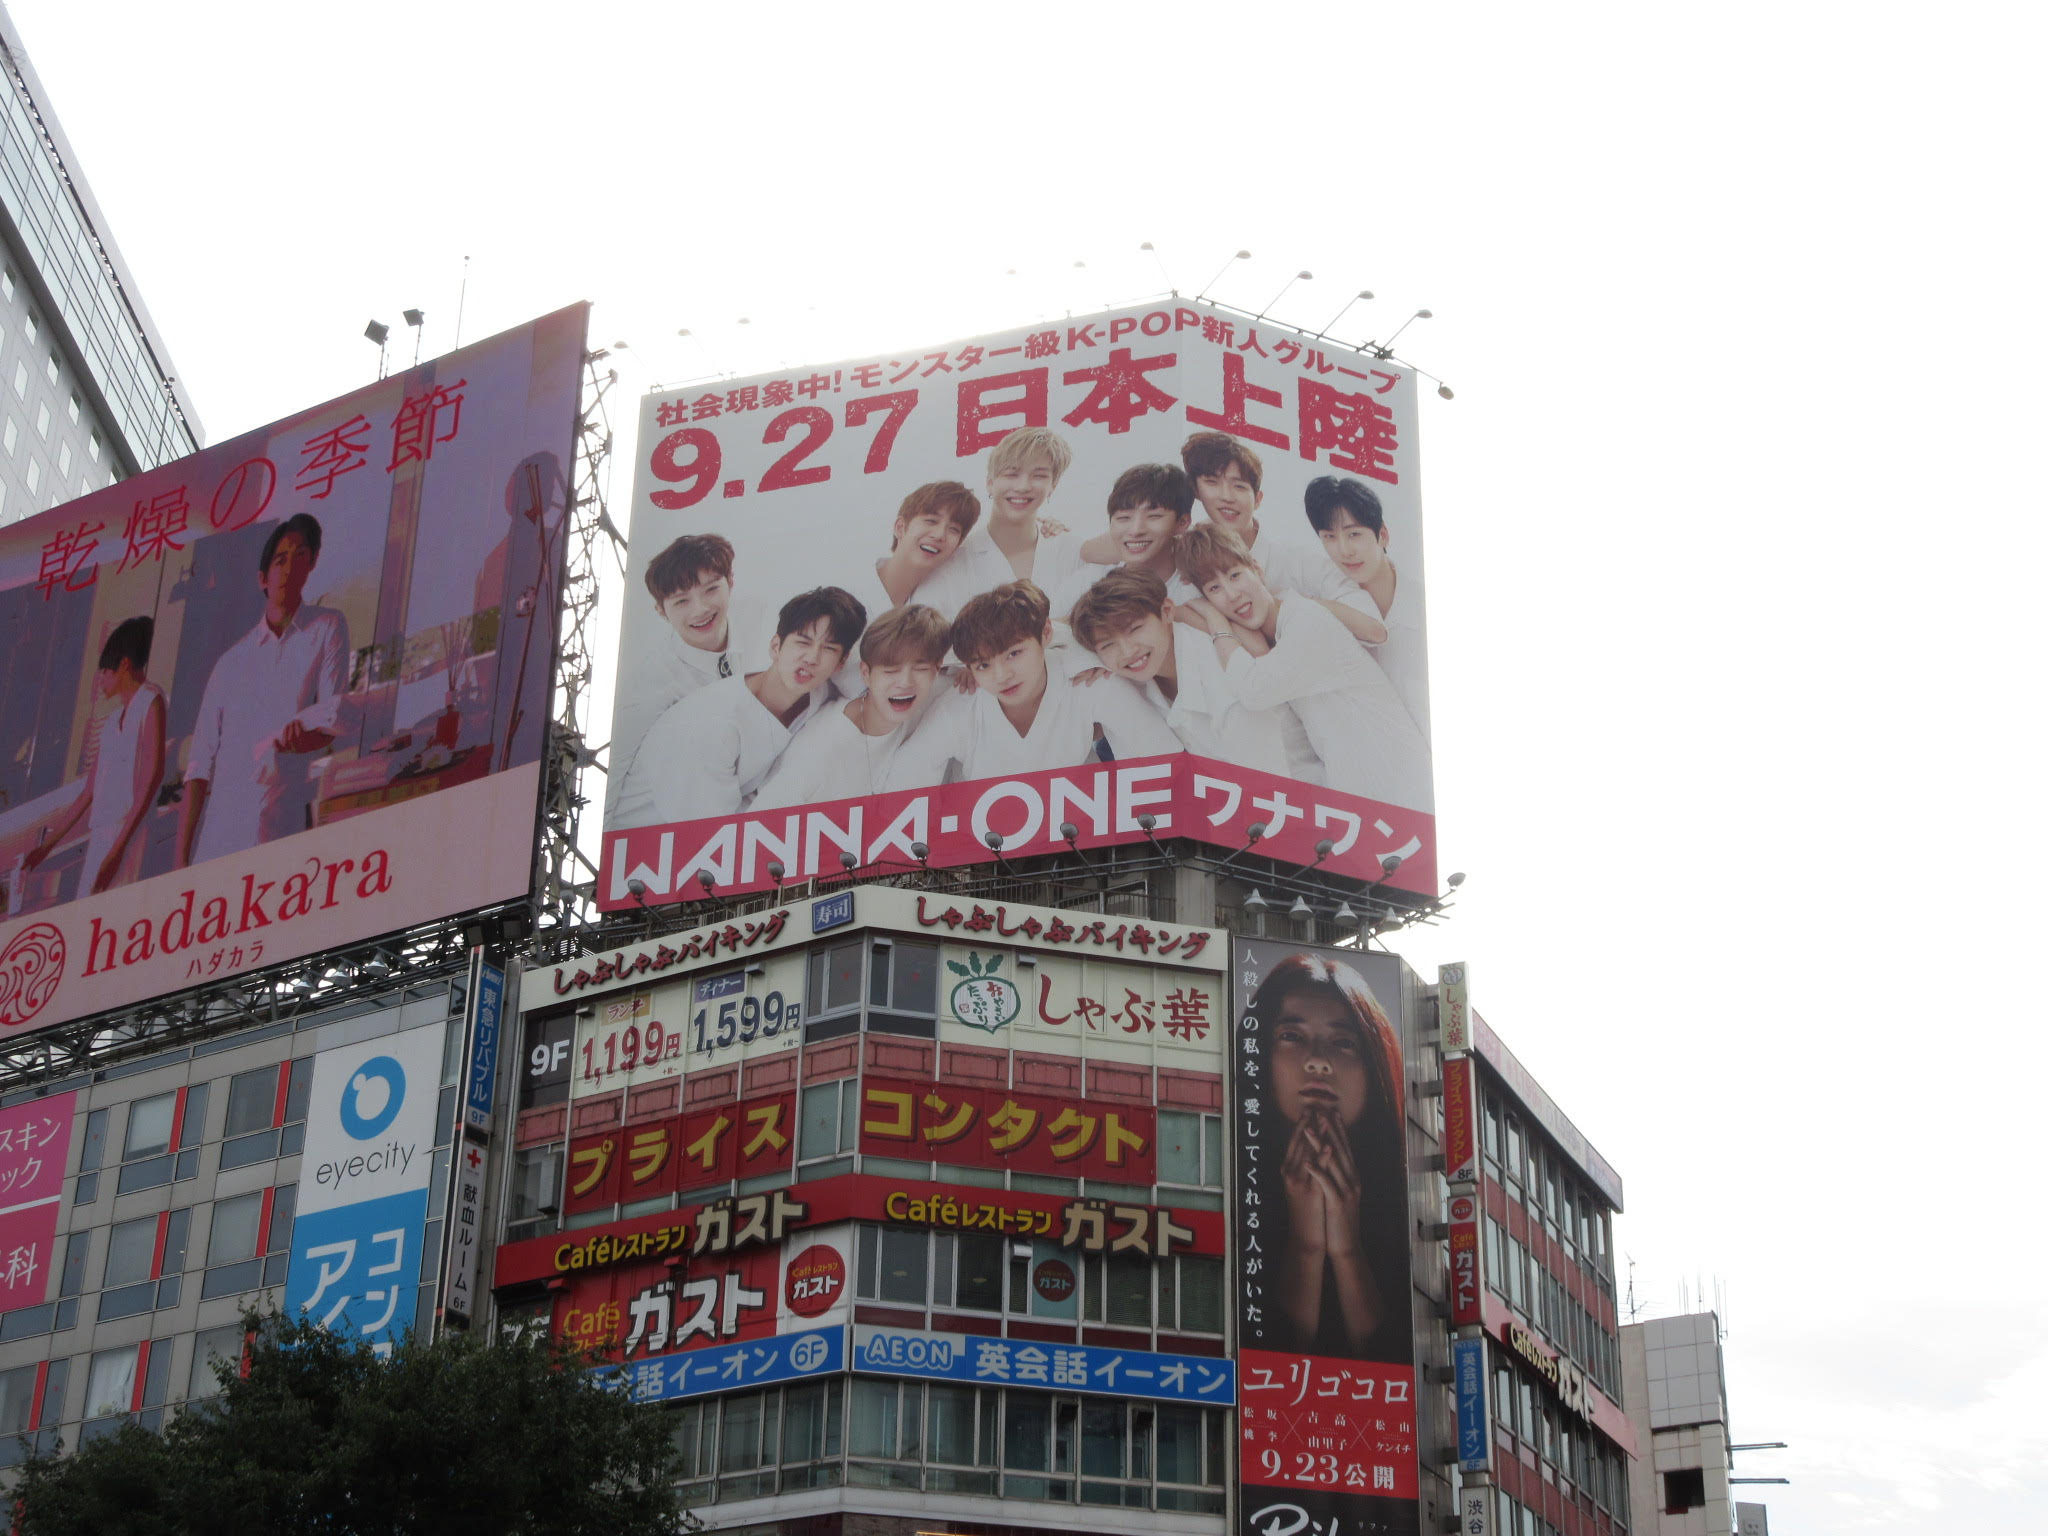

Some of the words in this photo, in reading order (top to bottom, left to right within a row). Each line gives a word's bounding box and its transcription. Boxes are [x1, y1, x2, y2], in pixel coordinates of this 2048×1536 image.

[956, 347, 1399, 486] 日本上陸
[35, 379, 468, 601] 乾燥の季節
[1194, 773, 1422, 864] ワナワン
[81, 850, 392, 978] hadakara
[815, 897, 851, 925] 寿司
[916, 896, 1211, 959] しゃぶしゃぶバイキング
[187, 940, 265, 977] ハダカラ
[553, 910, 790, 995] しゃぶしゃぶバイキング
[699, 975, 743, 998] ディナー
[1038, 974, 1211, 1042] しゃぶ葉
[473, 988, 497, 1102] 東急リバブル
[530, 1039, 571, 1076] 9F
[471, 1110, 486, 1125] 9F
[864, 1088, 1145, 1163] コンタクト
[1242, 949, 1263, 1338] 人殺しの私を、愛してくれる人がいた。
[316, 1140, 415, 1190] eyecity
[572, 1103, 787, 1195] プライス
[1457, 1168, 1472, 1180] 8F
[455, 1183, 477, 1292] 献血ルーム
[694, 1192, 804, 1256] ガスト
[1063, 1201, 1194, 1257] ガスト
[0, 1242, 39, 1290] 科
[362, 1228, 405, 1364] コン
[793, 1275, 839, 1300] ガスト
[1456, 1249, 1474, 1310] ガスト
[453, 1296, 466, 1310] 6F
[563, 1301, 620, 1337] Café
[626, 1273, 765, 1356] ガスト
[795, 1341, 825, 1365] 6F
[868, 1335, 952, 1368] AEON
[976, 1342, 1227, 1395] 英会話イーオン
[1243, 1359, 1409, 1406] ユリゴコロ
[1463, 1352, 1480, 1458] 英会話イーオン
